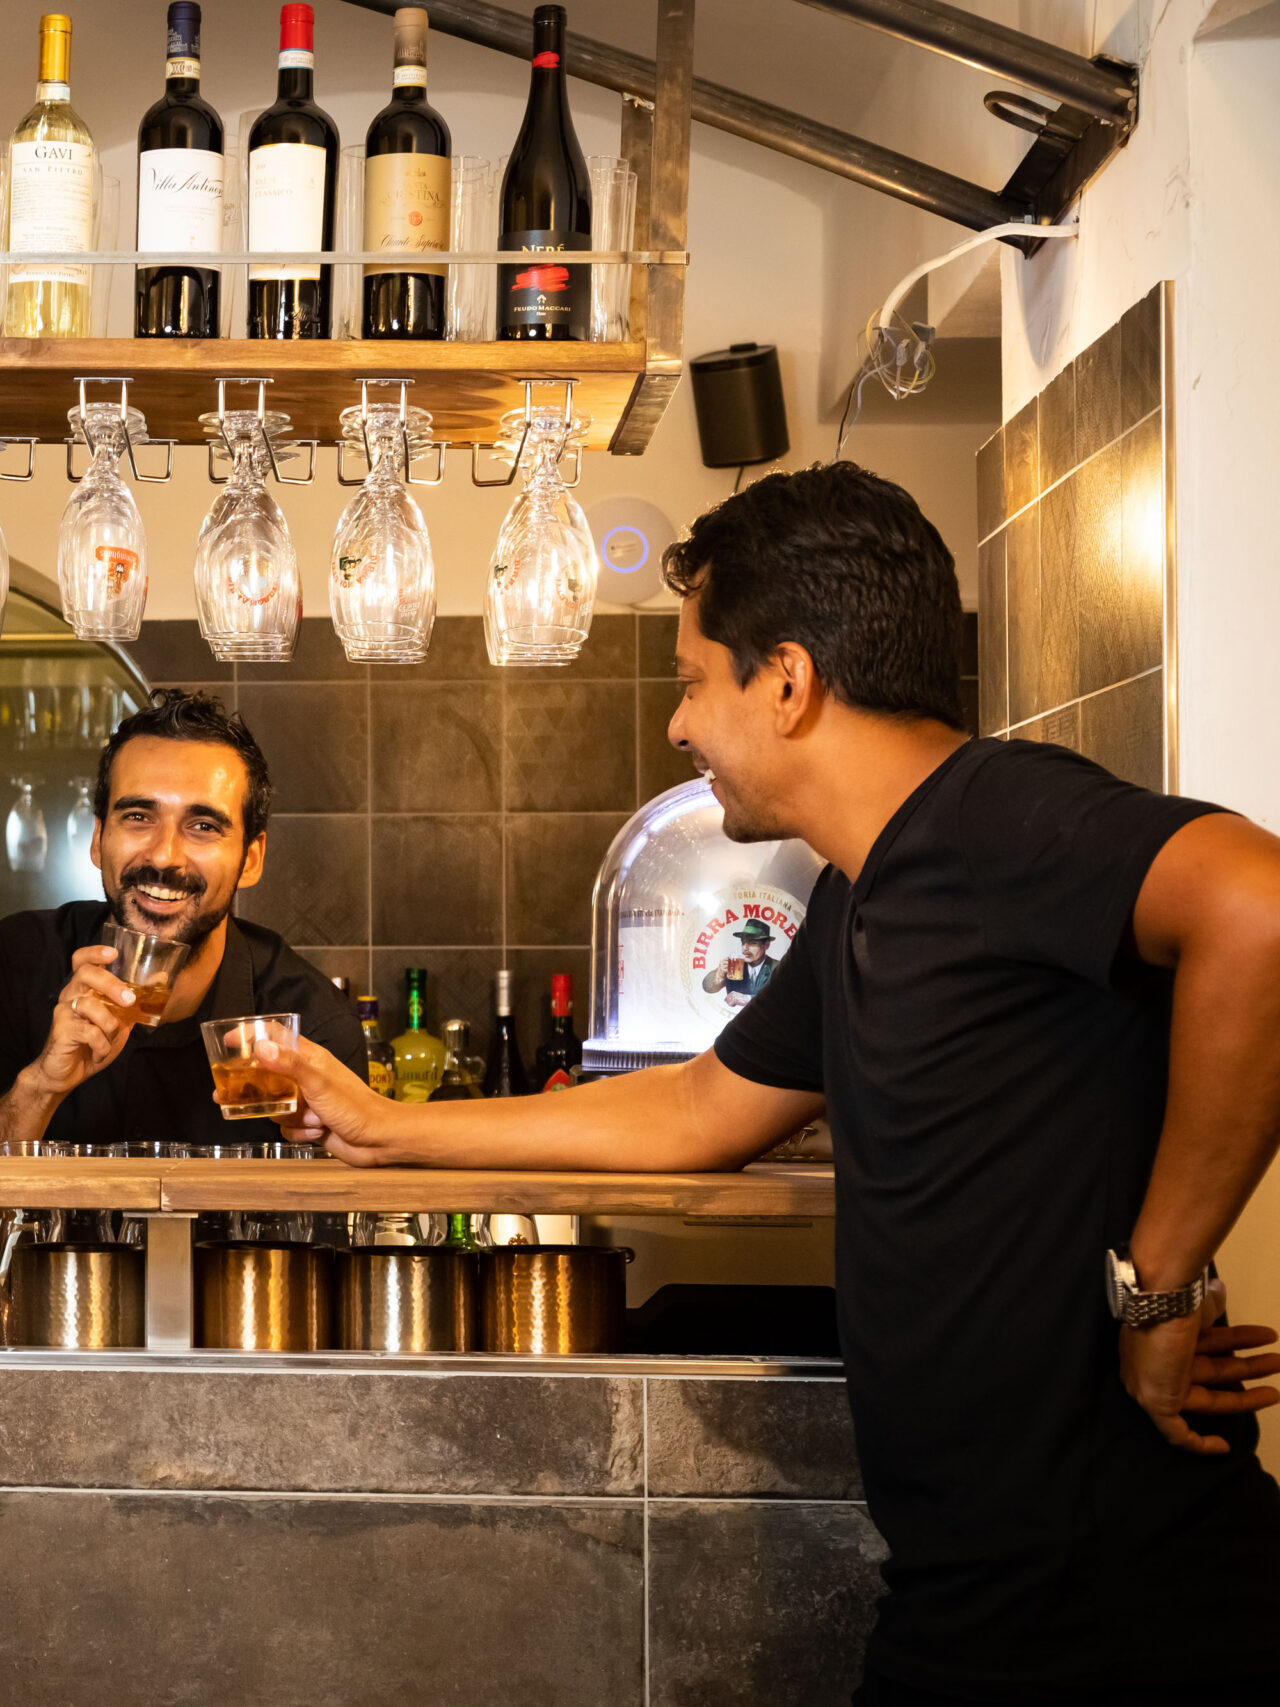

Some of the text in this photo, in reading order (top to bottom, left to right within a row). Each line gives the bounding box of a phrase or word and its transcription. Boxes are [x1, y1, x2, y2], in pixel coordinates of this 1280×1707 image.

[34, 145, 73, 160] GAVI
[759, 891, 793, 912] ITALIANA
[692, 904, 800, 970] BIRRA MORE
